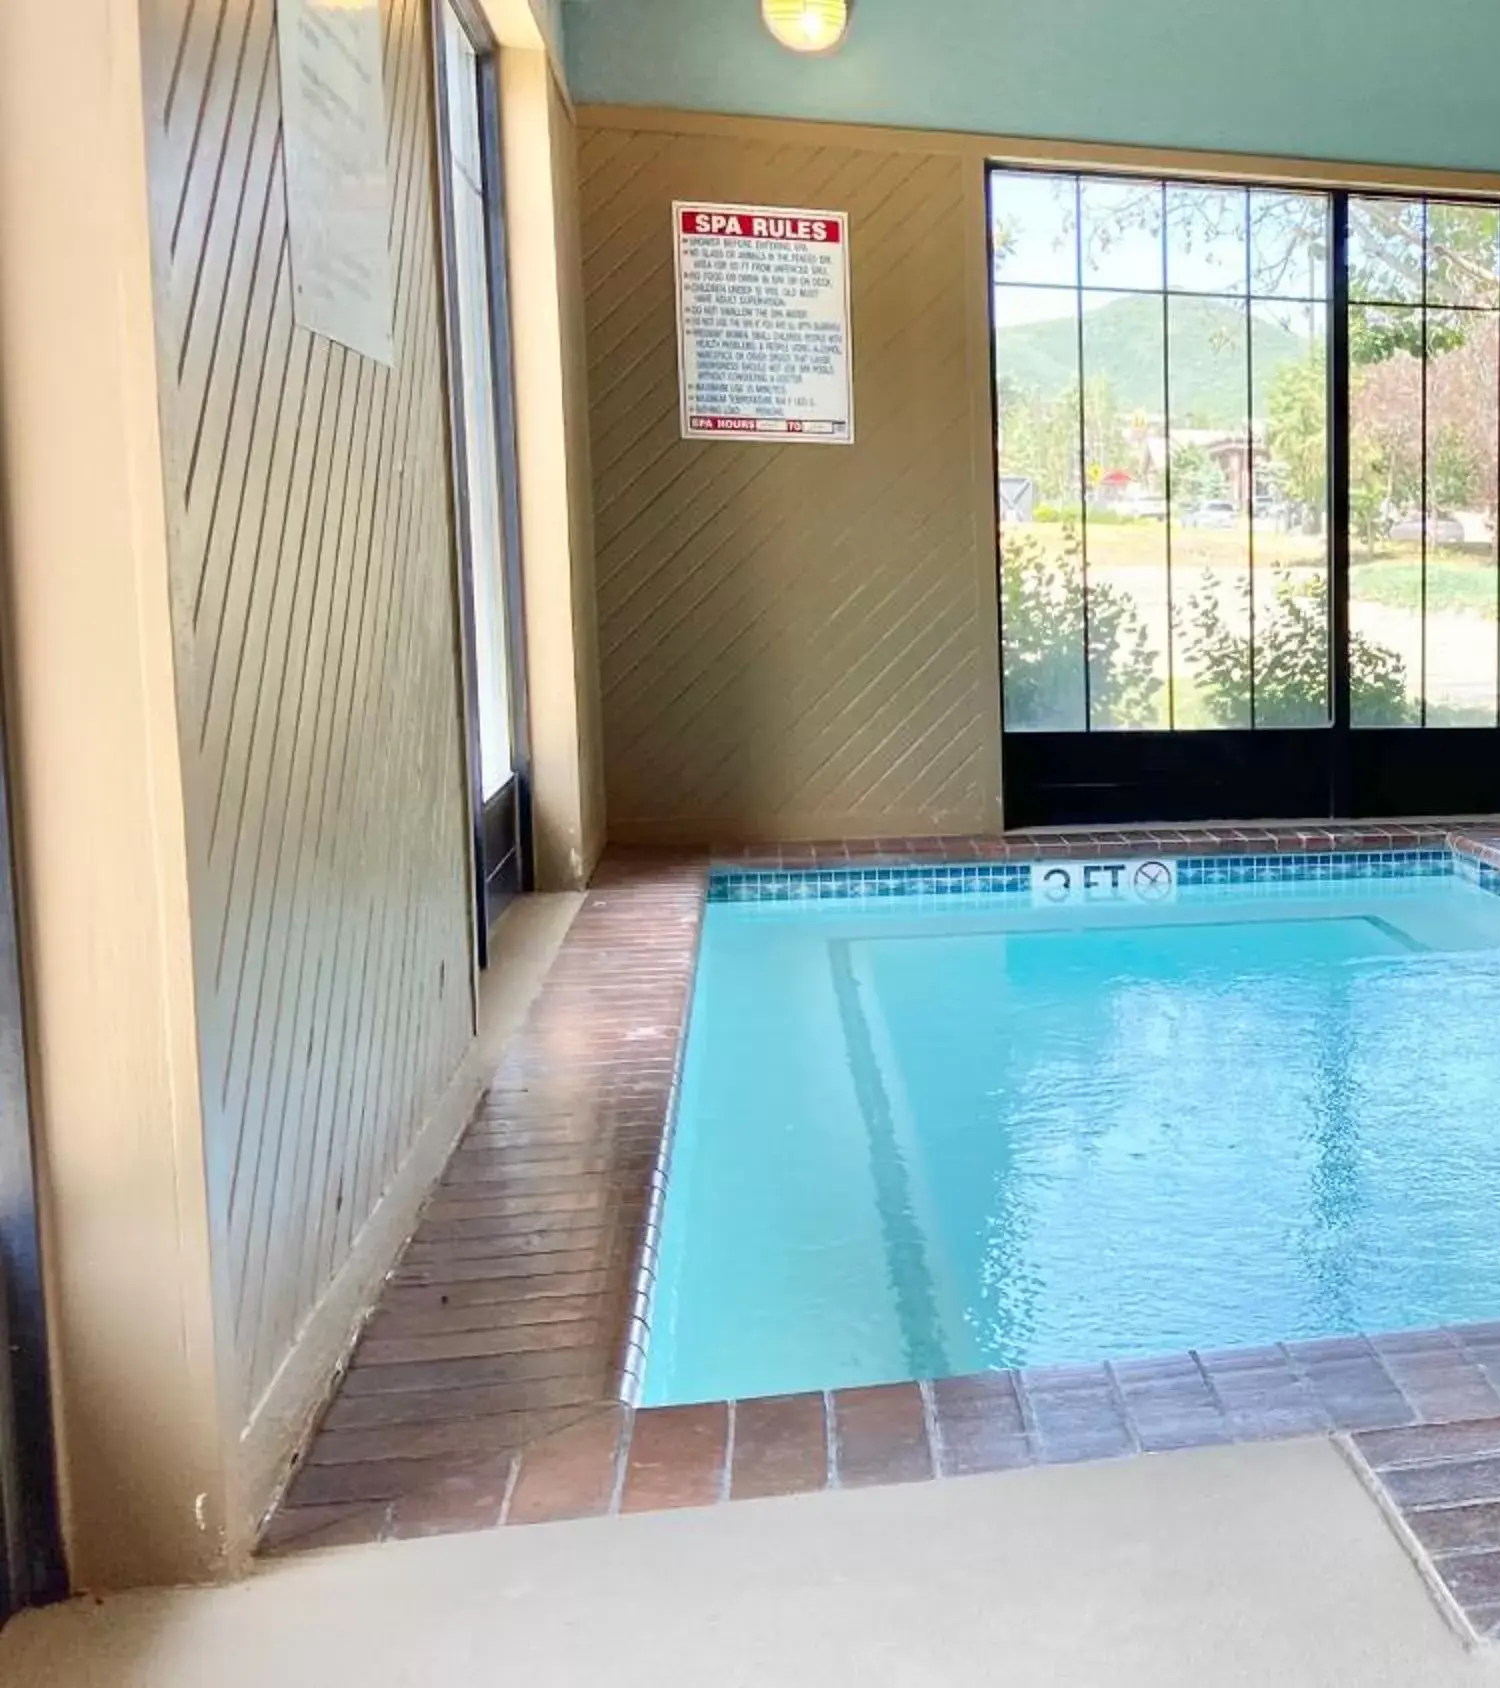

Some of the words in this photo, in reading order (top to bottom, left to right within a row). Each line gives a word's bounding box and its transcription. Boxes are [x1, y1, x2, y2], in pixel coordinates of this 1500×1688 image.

[695, 214, 742, 235] SPA
[752, 217, 827, 241] RULES
[717, 419, 754, 430] HOURS
[789, 421, 801, 431] TO
[1083, 864, 1126, 898] FT
